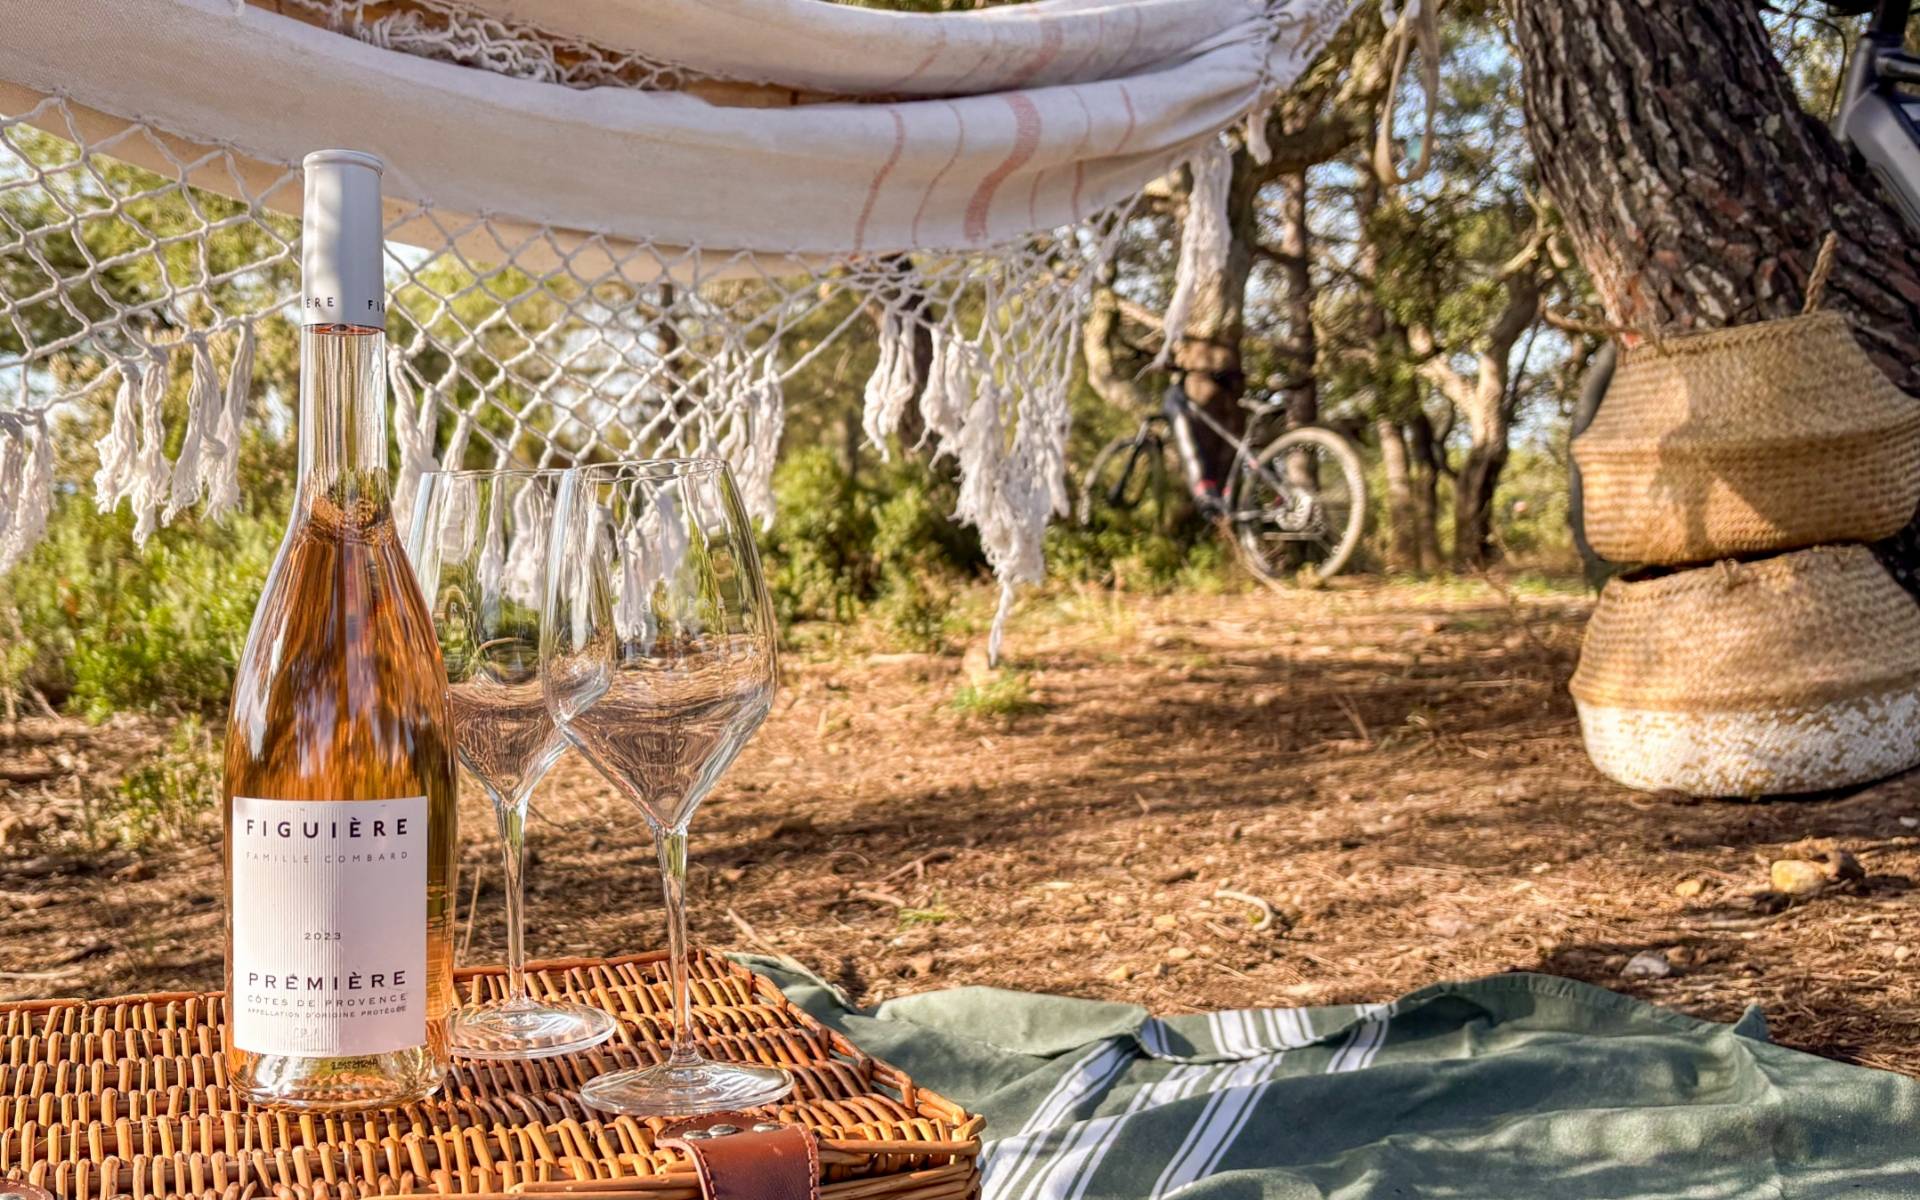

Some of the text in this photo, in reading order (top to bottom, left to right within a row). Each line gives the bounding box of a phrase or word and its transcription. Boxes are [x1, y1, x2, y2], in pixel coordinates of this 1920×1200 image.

[246, 817, 408, 839] FIGUIÈRE
[246, 851, 408, 864] FAMILLE COMBARD
[303, 932, 341, 941] 2023
[247, 992, 407, 1008] CÔTES DE PROVENCE
[247, 1007, 300, 1019] APPELLATION
[305, 1011, 356, 1019] D'ORIGINE
